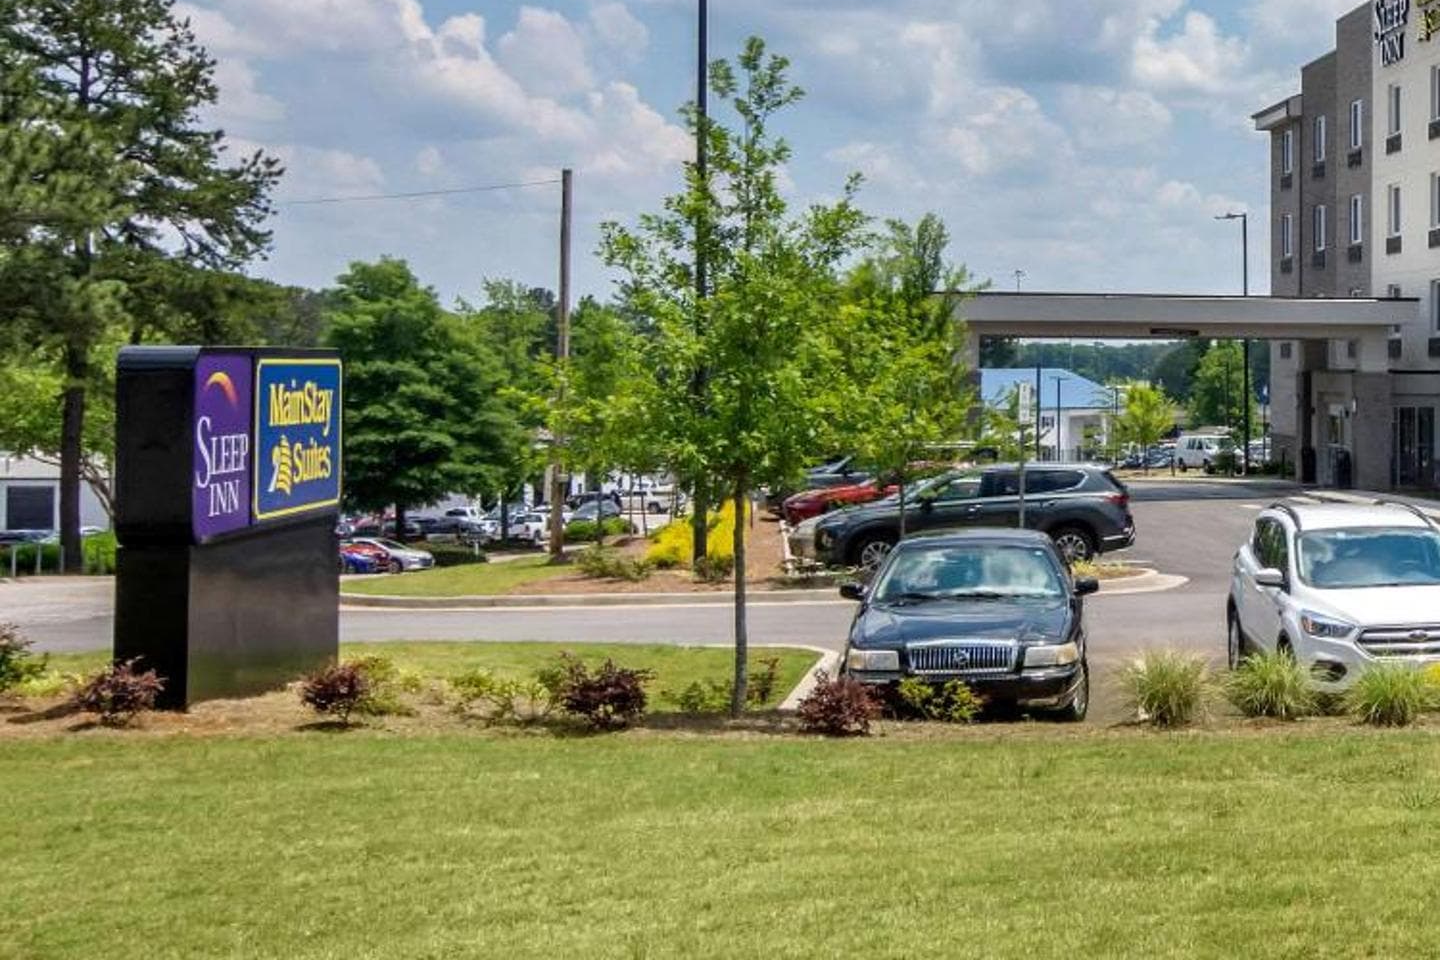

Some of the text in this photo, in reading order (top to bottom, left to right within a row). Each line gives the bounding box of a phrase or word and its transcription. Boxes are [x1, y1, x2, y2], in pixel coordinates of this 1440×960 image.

[269, 379, 333, 436] MainStay
[195, 416, 249, 488] SLEEP
[292, 437, 332, 484] Suites
[208, 479, 241, 517] INN
